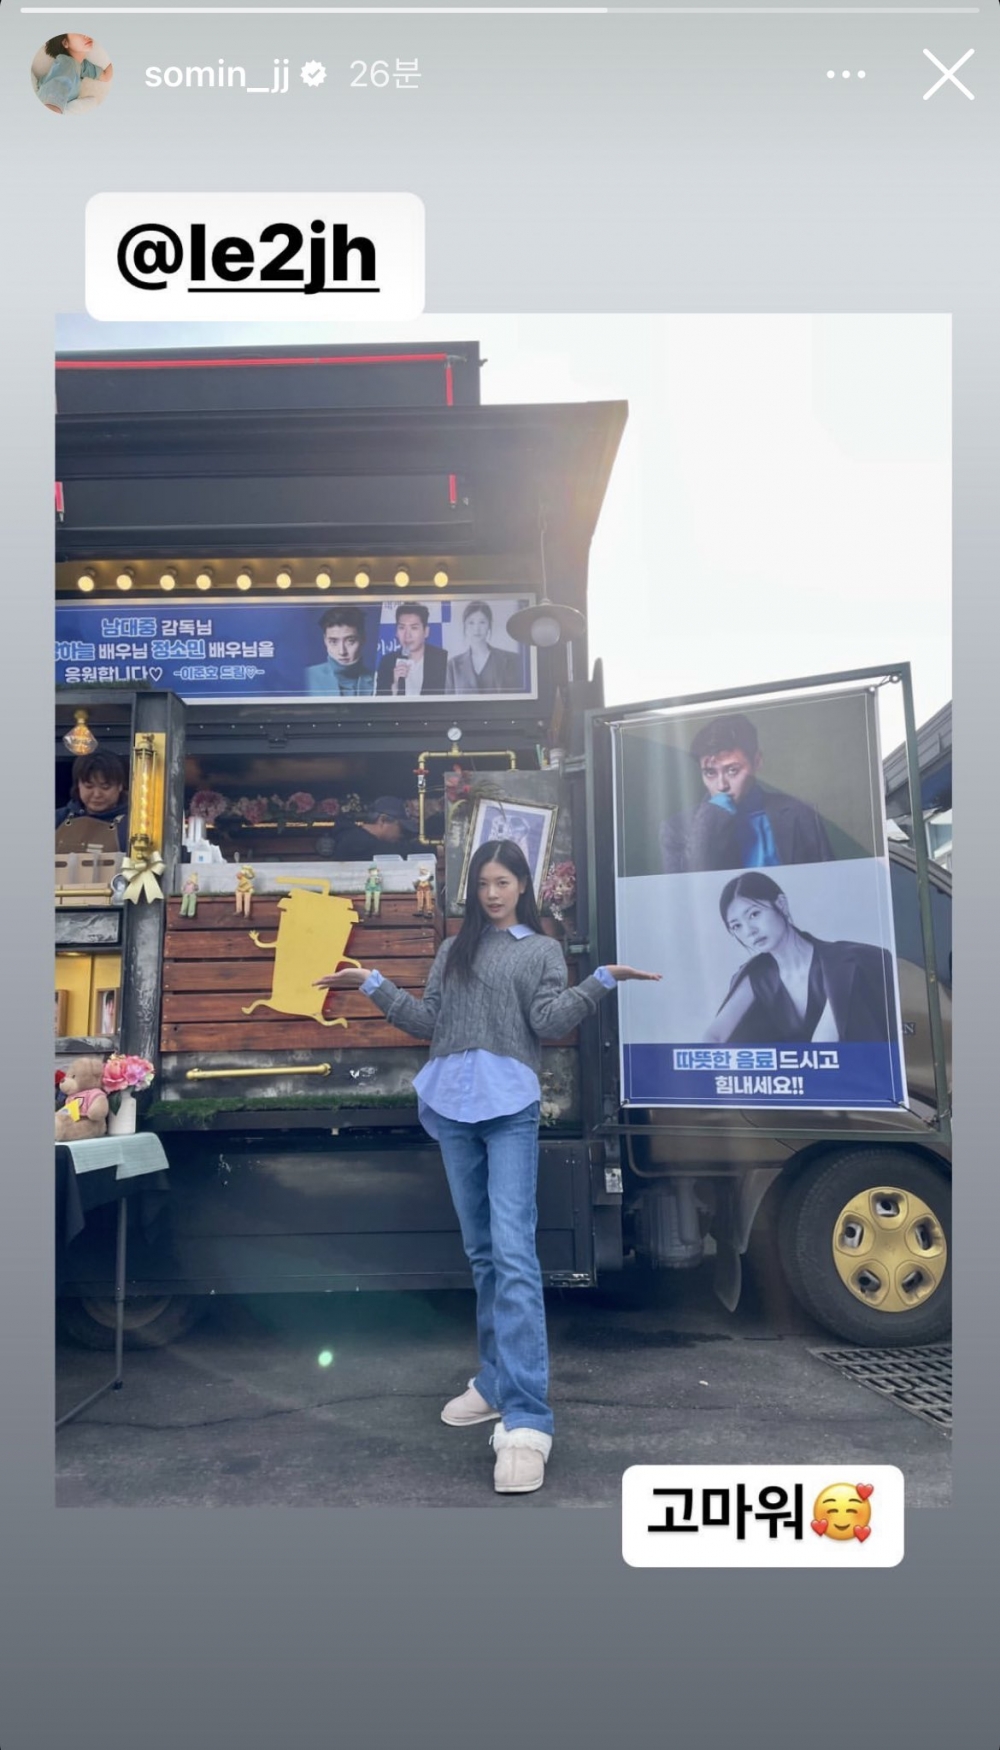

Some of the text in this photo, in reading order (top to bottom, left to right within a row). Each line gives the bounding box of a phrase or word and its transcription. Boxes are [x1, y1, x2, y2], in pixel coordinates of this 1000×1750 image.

[101, 617, 213, 638] 남대중 감독님
[98, 643, 148, 660] 배우님
[151, 639, 206, 660] 정소민
[208, 640, 274, 659] 배우님을
[675, 1050, 840, 1070] 따뜻한 음료 드시고
[715, 1075, 804, 1096] 힘내세요!!
